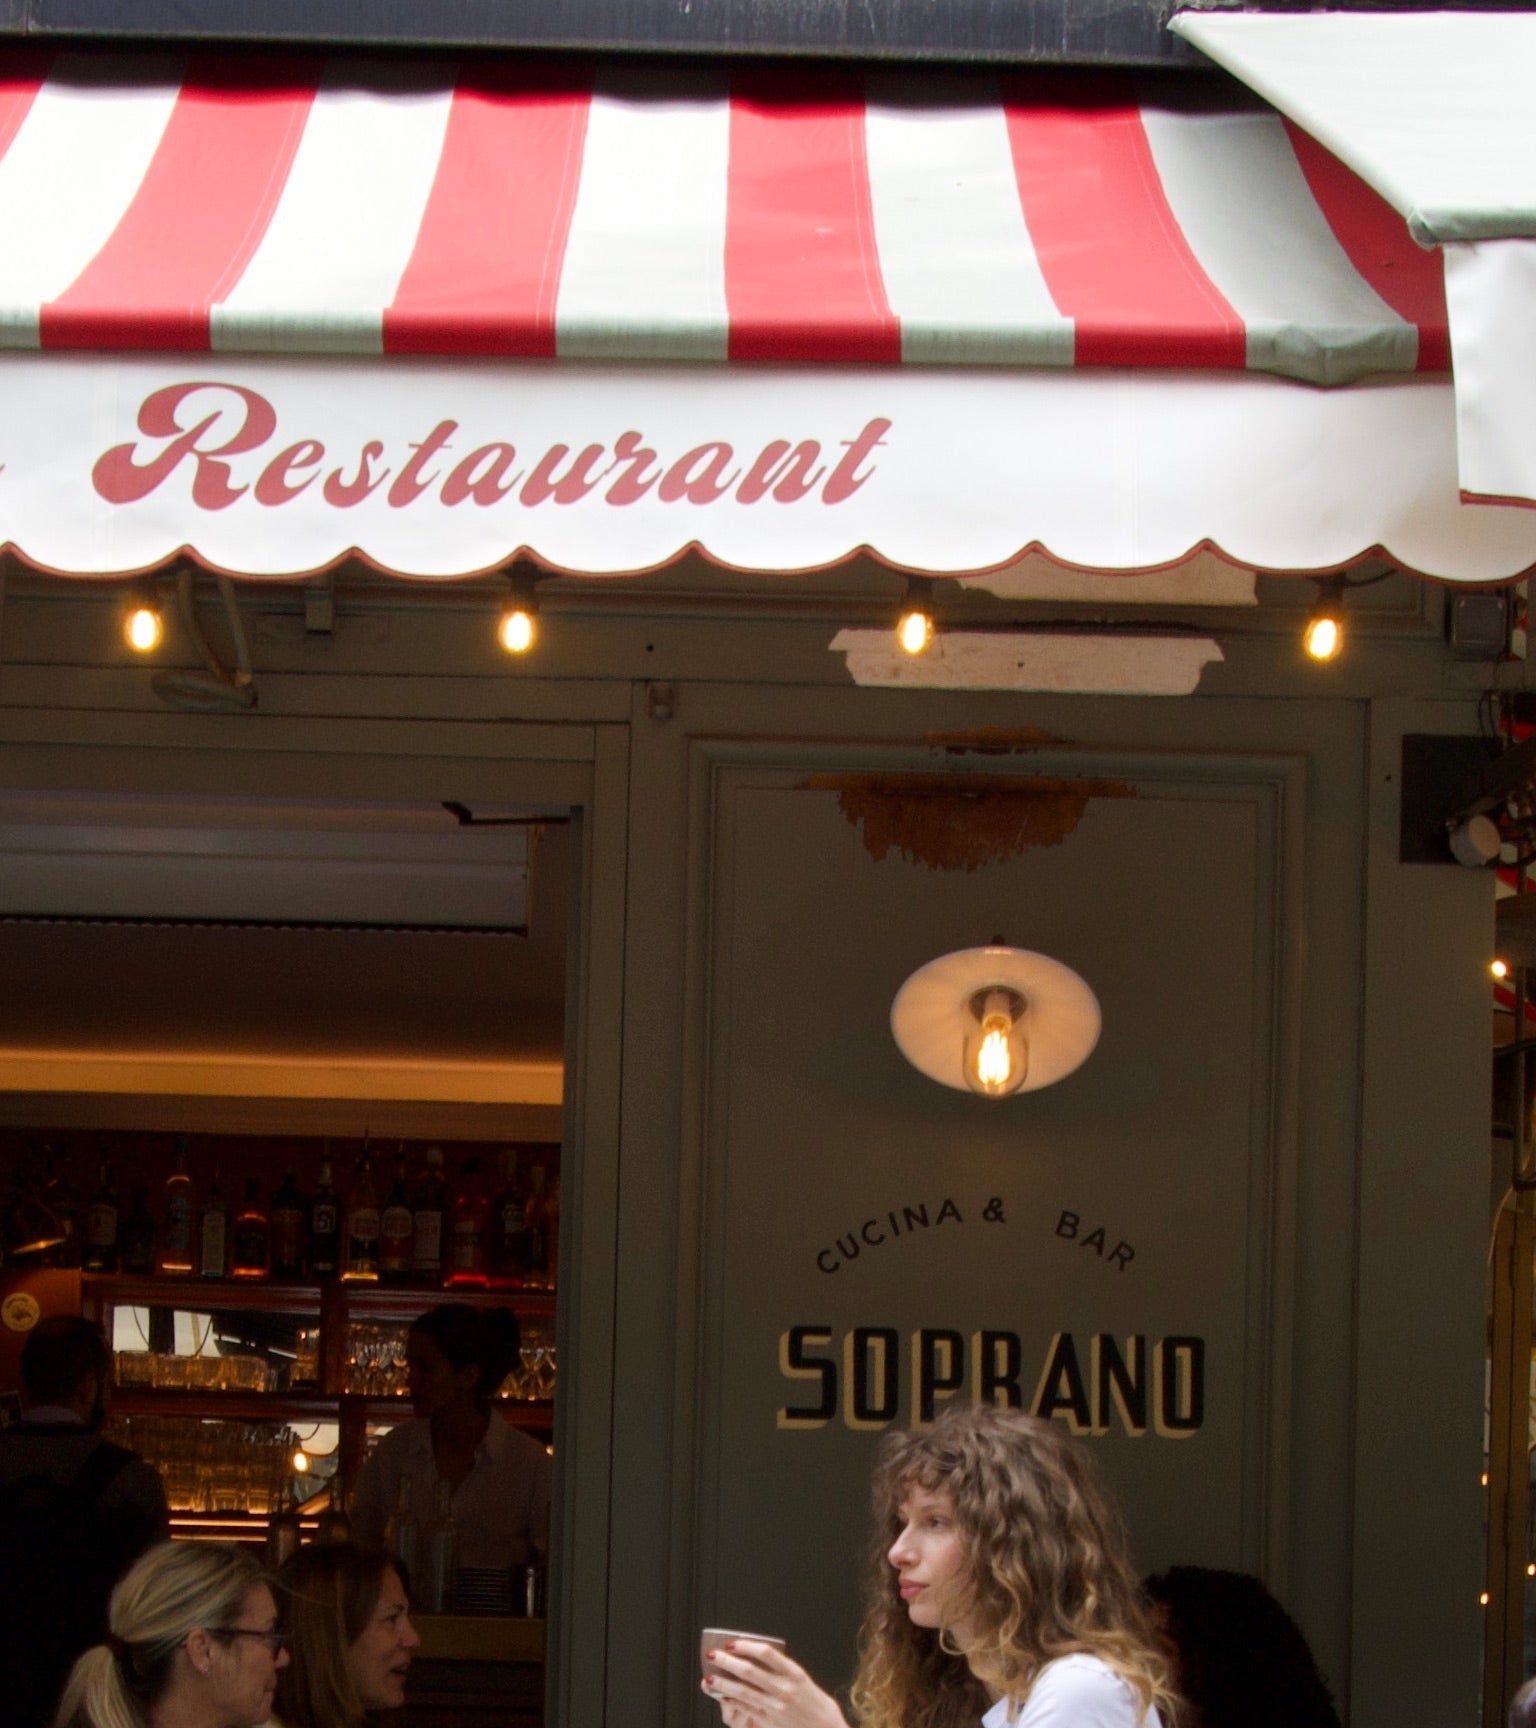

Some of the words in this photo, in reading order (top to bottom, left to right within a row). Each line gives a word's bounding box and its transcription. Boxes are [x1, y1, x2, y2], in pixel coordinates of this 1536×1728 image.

[91, 381, 893, 511] Restaurant
[817, 1198, 964, 1274] CUCINA
[981, 1197, 1007, 1224] &
[1054, 1210, 1137, 1272] BAR
[776, 1325, 1206, 1440] SOPRANO
